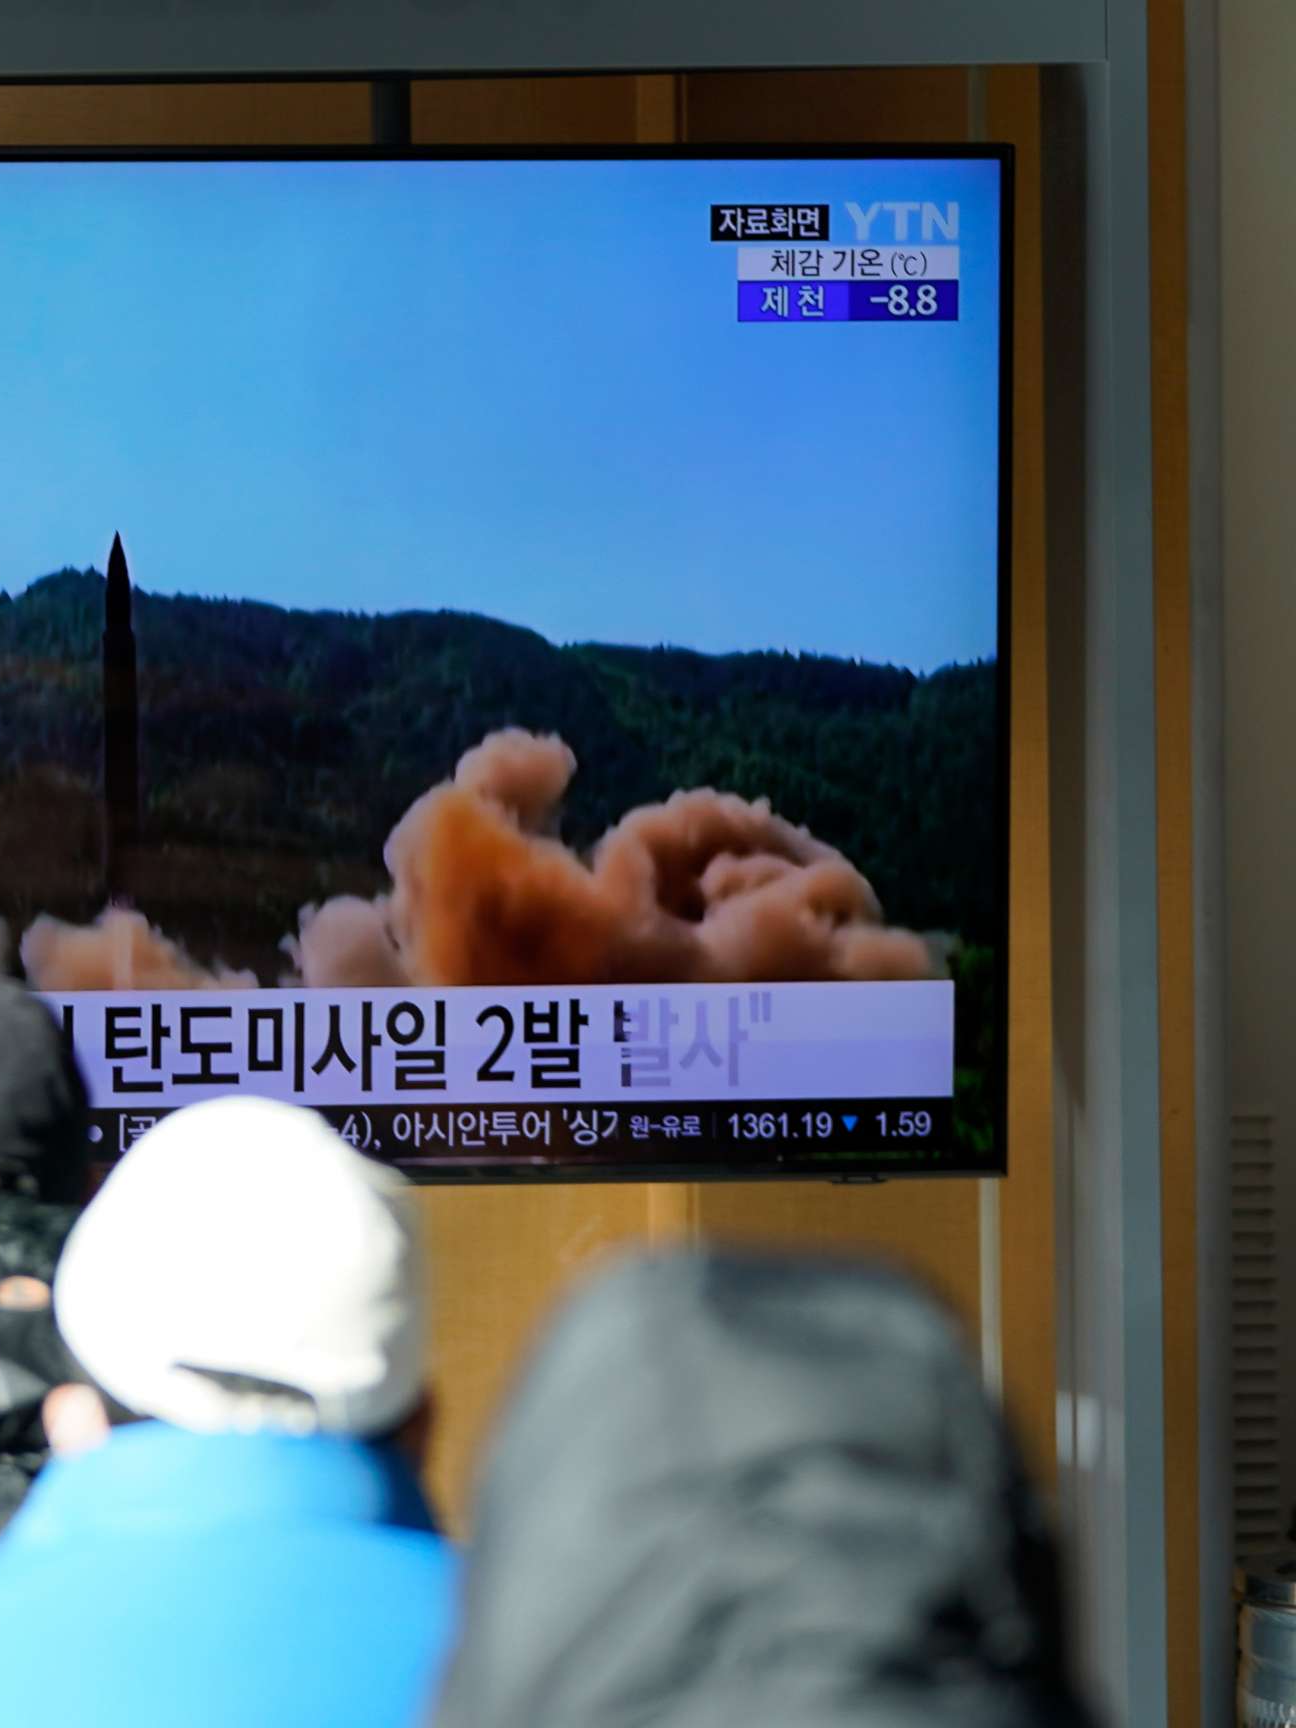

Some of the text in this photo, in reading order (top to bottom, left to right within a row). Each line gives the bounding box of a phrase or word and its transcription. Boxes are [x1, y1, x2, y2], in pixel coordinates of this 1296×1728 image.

[718, 207, 821, 238] 자료화면
[844, 201, 960, 241] YTN
[770, 249, 824, 277] 체감
[832, 249, 884, 277] 기온
[869, 284, 938, 315] -8.8
[104, 999, 447, 1093] 탄도미사일
[475, 998, 589, 1089] 2발
[392, 1110, 551, 1147] 아시안투어
[629, 1111, 931, 1139] 원-유로 1361.19 1.59
